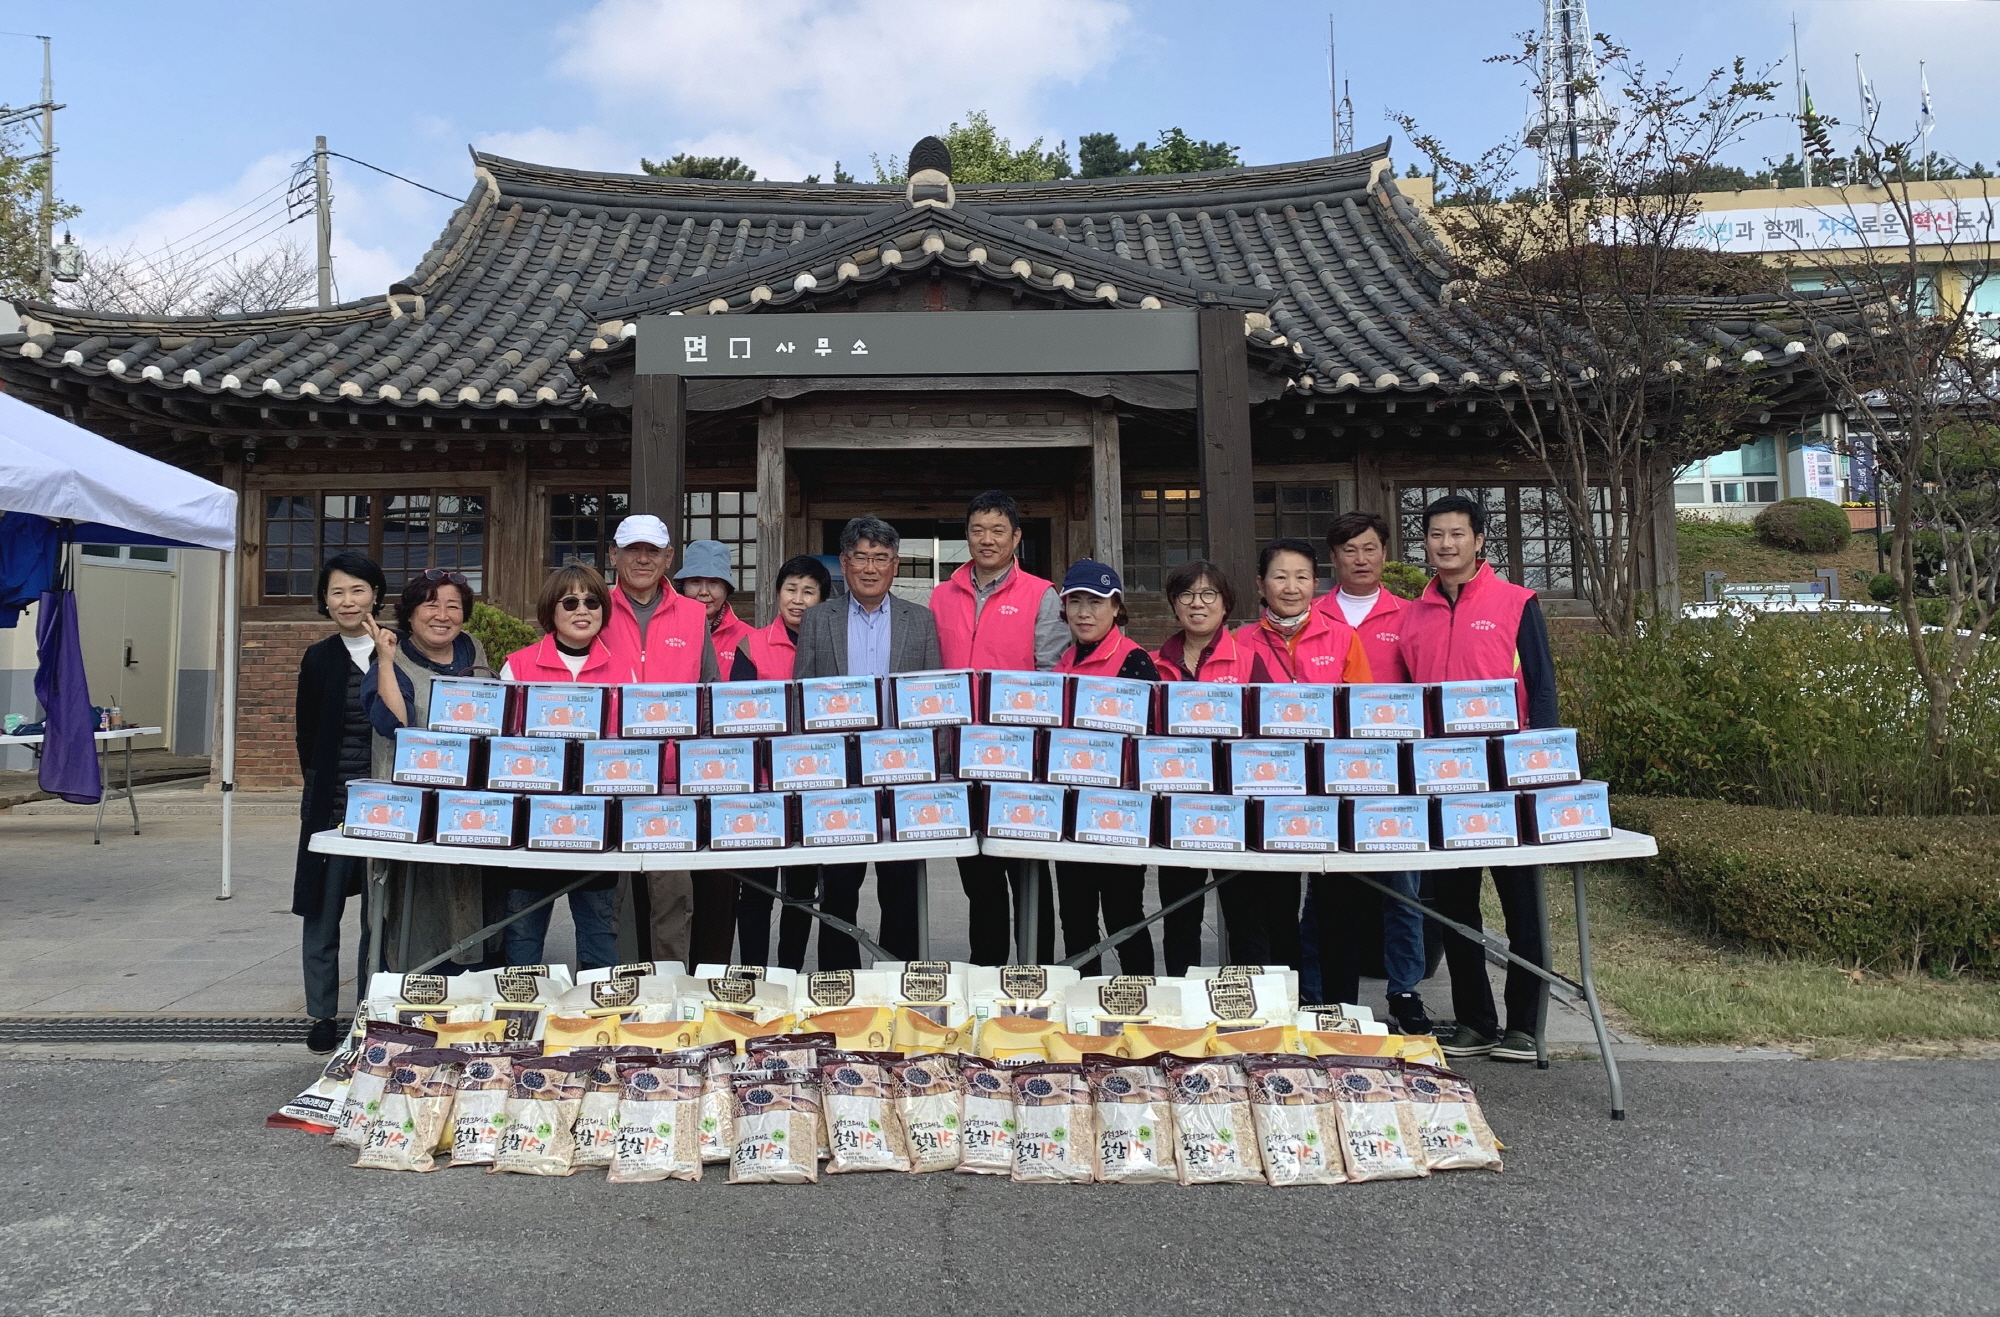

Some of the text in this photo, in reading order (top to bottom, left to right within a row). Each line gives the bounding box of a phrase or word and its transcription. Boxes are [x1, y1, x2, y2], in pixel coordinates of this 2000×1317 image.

[1764, 218, 1811, 241] 함께,
[1818, 212, 1901, 237] 자유로운
[1912, 208, 1995, 232] 혁신도시
[684, 335, 708, 362] 면
[815, 718, 867, 728] 대부동주민자치회
[1000, 714, 1051, 725] 대부동주민자치회
[633, 727, 685, 735] 대부동주민자치회
[723, 724, 775, 733] 대부동주민자치회
[1084, 719, 1136, 733] 대부동주민자치회
[1178, 726, 1231, 736] 대부동주민자치회
[1454, 722, 1507, 731] 대부동주민자치회
[1270, 727, 1322, 737] 대부동주민자치회
[1361, 729, 1413, 737] 대부동주민자치회
[403, 773, 456, 785] 대부동주민자치회
[872, 774, 924, 783] 대부동주민자치회
[969, 769, 1021, 780] 대부동주민자치회
[1517, 773, 1569, 784] 대부동주민자치회
[498, 780, 551, 790] 대부동주민자치회
[783, 780, 835, 789] 대부동주민자치회
[1058, 774, 1109, 786] 대부동주민자치회
[593, 785, 646, 793] 대부동주민자치회
[690, 784, 742, 793] 대부동주민자치회
[1150, 783, 1202, 791] 대부동주민자치회
[1335, 785, 1388, 793] 대부동주민자치회
[1426, 783, 1478, 792] 대부동주민자치회
[353, 828, 406, 840] 대부동주민자치회
[906, 829, 959, 838] 대부동주민자치회
[997, 828, 1050, 839] 대부동주민자치회
[1549, 830, 1601, 841] 대부동주민자치회
[721, 839, 773, 847] 대부동주민자치회
[813, 835, 866, 844] 대부동주민자치회
[1086, 833, 1138, 845] 대부동주민자치회
[1454, 838, 1507, 847] 대부동주민자치회
[539, 840, 592, 850] 대부동주민자치회
[632, 842, 685, 850] 대부동주민자치회
[1181, 840, 1233, 850] 대부동주민자치회
[1274, 841, 1327, 851] 대부동주민자치회
